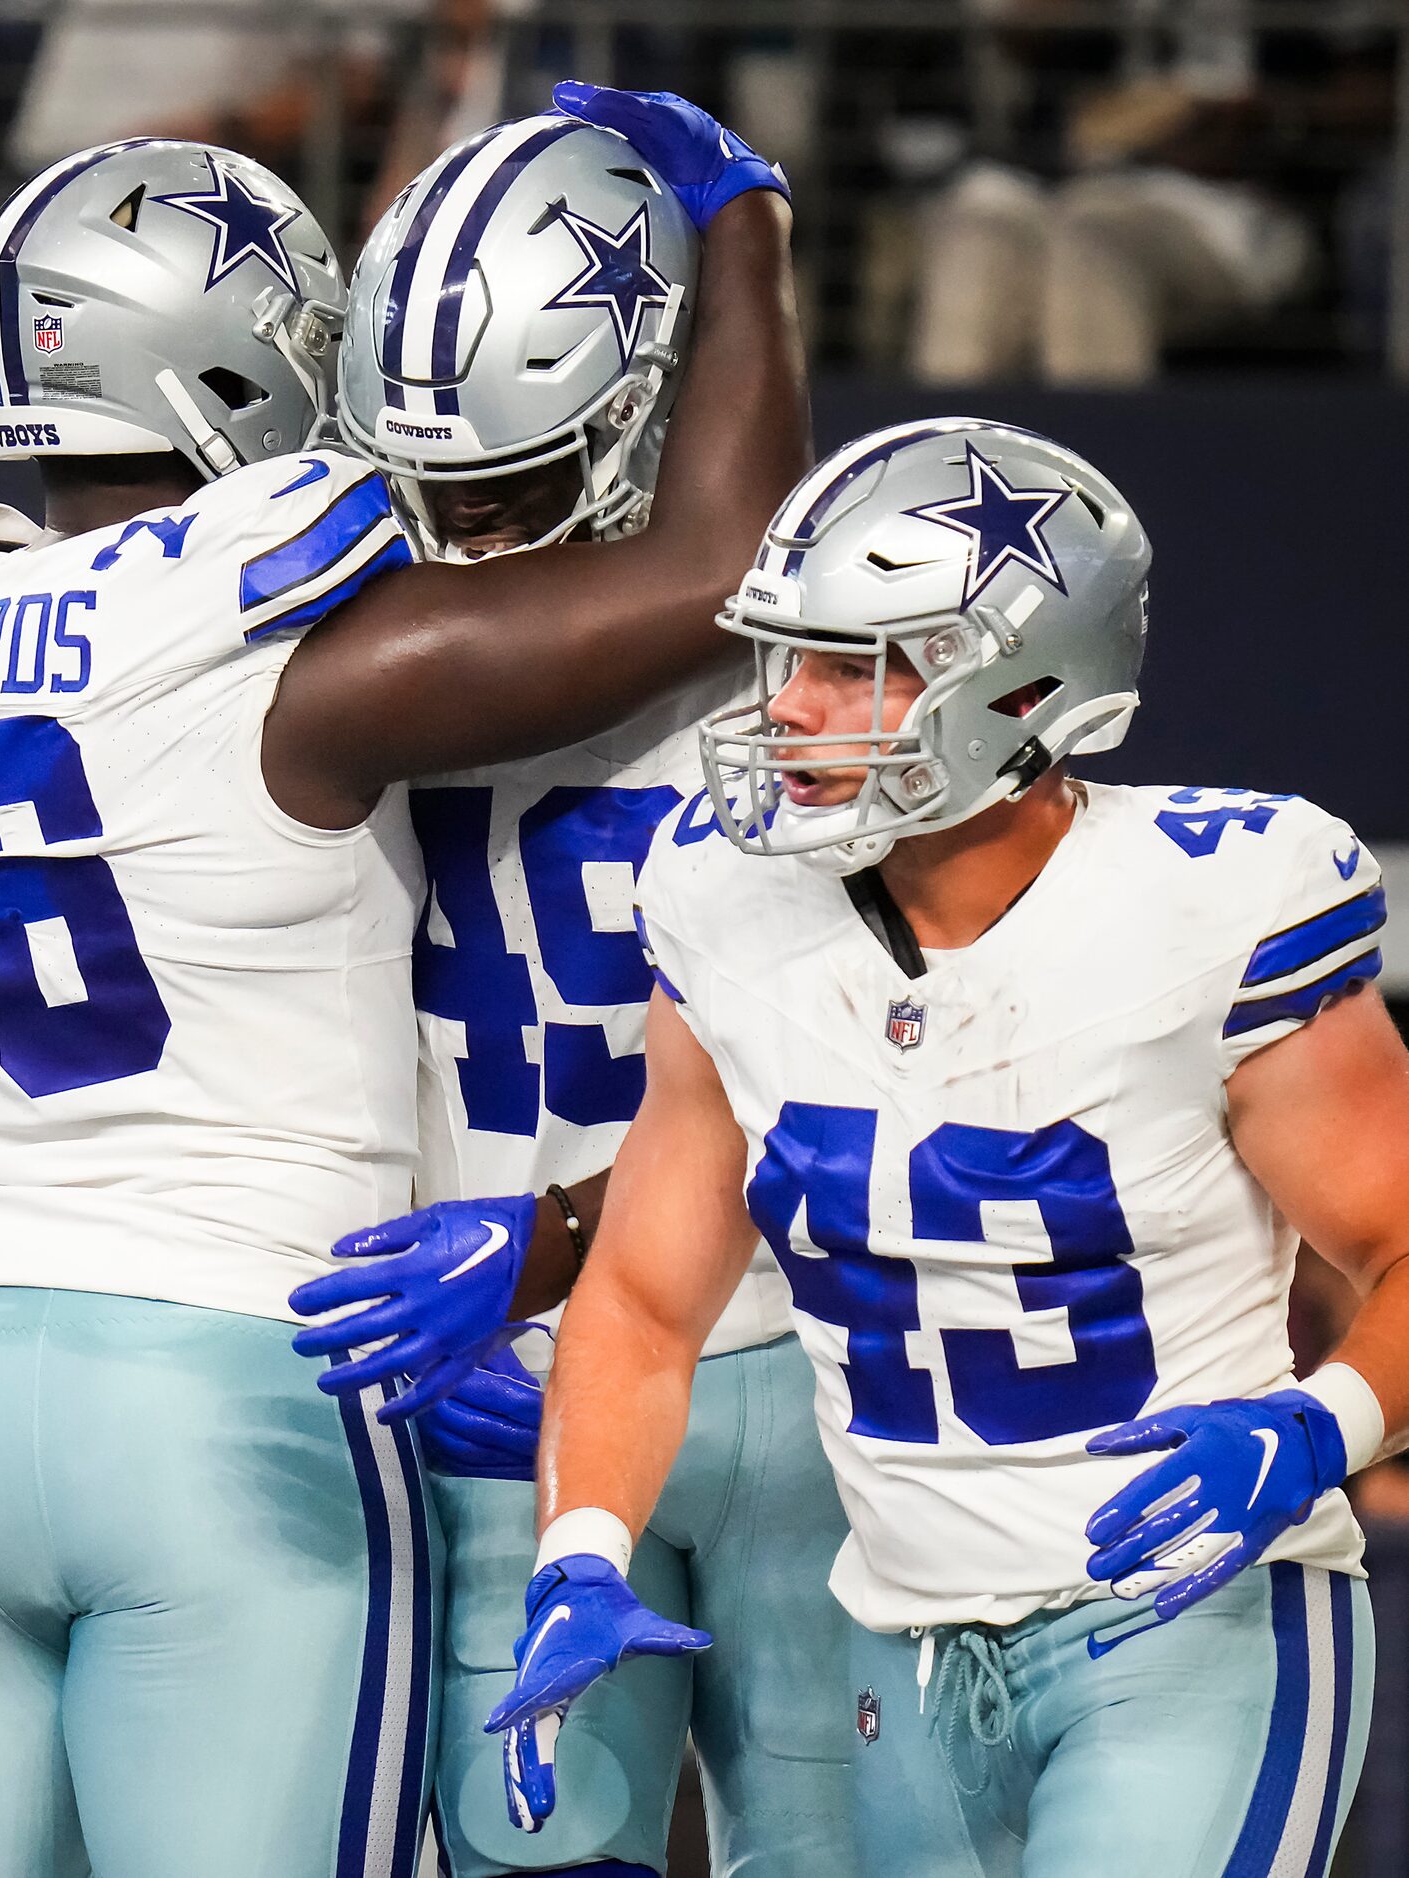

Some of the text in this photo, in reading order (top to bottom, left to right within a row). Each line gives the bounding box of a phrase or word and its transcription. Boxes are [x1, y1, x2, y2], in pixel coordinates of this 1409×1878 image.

[37, 331, 61, 349] NFL
[386, 420, 452, 439] COWBOYS
[412, 785, 685, 1139] 49
[891, 1021, 916, 1042] NFL
[747, 1101, 1158, 1445] 43
